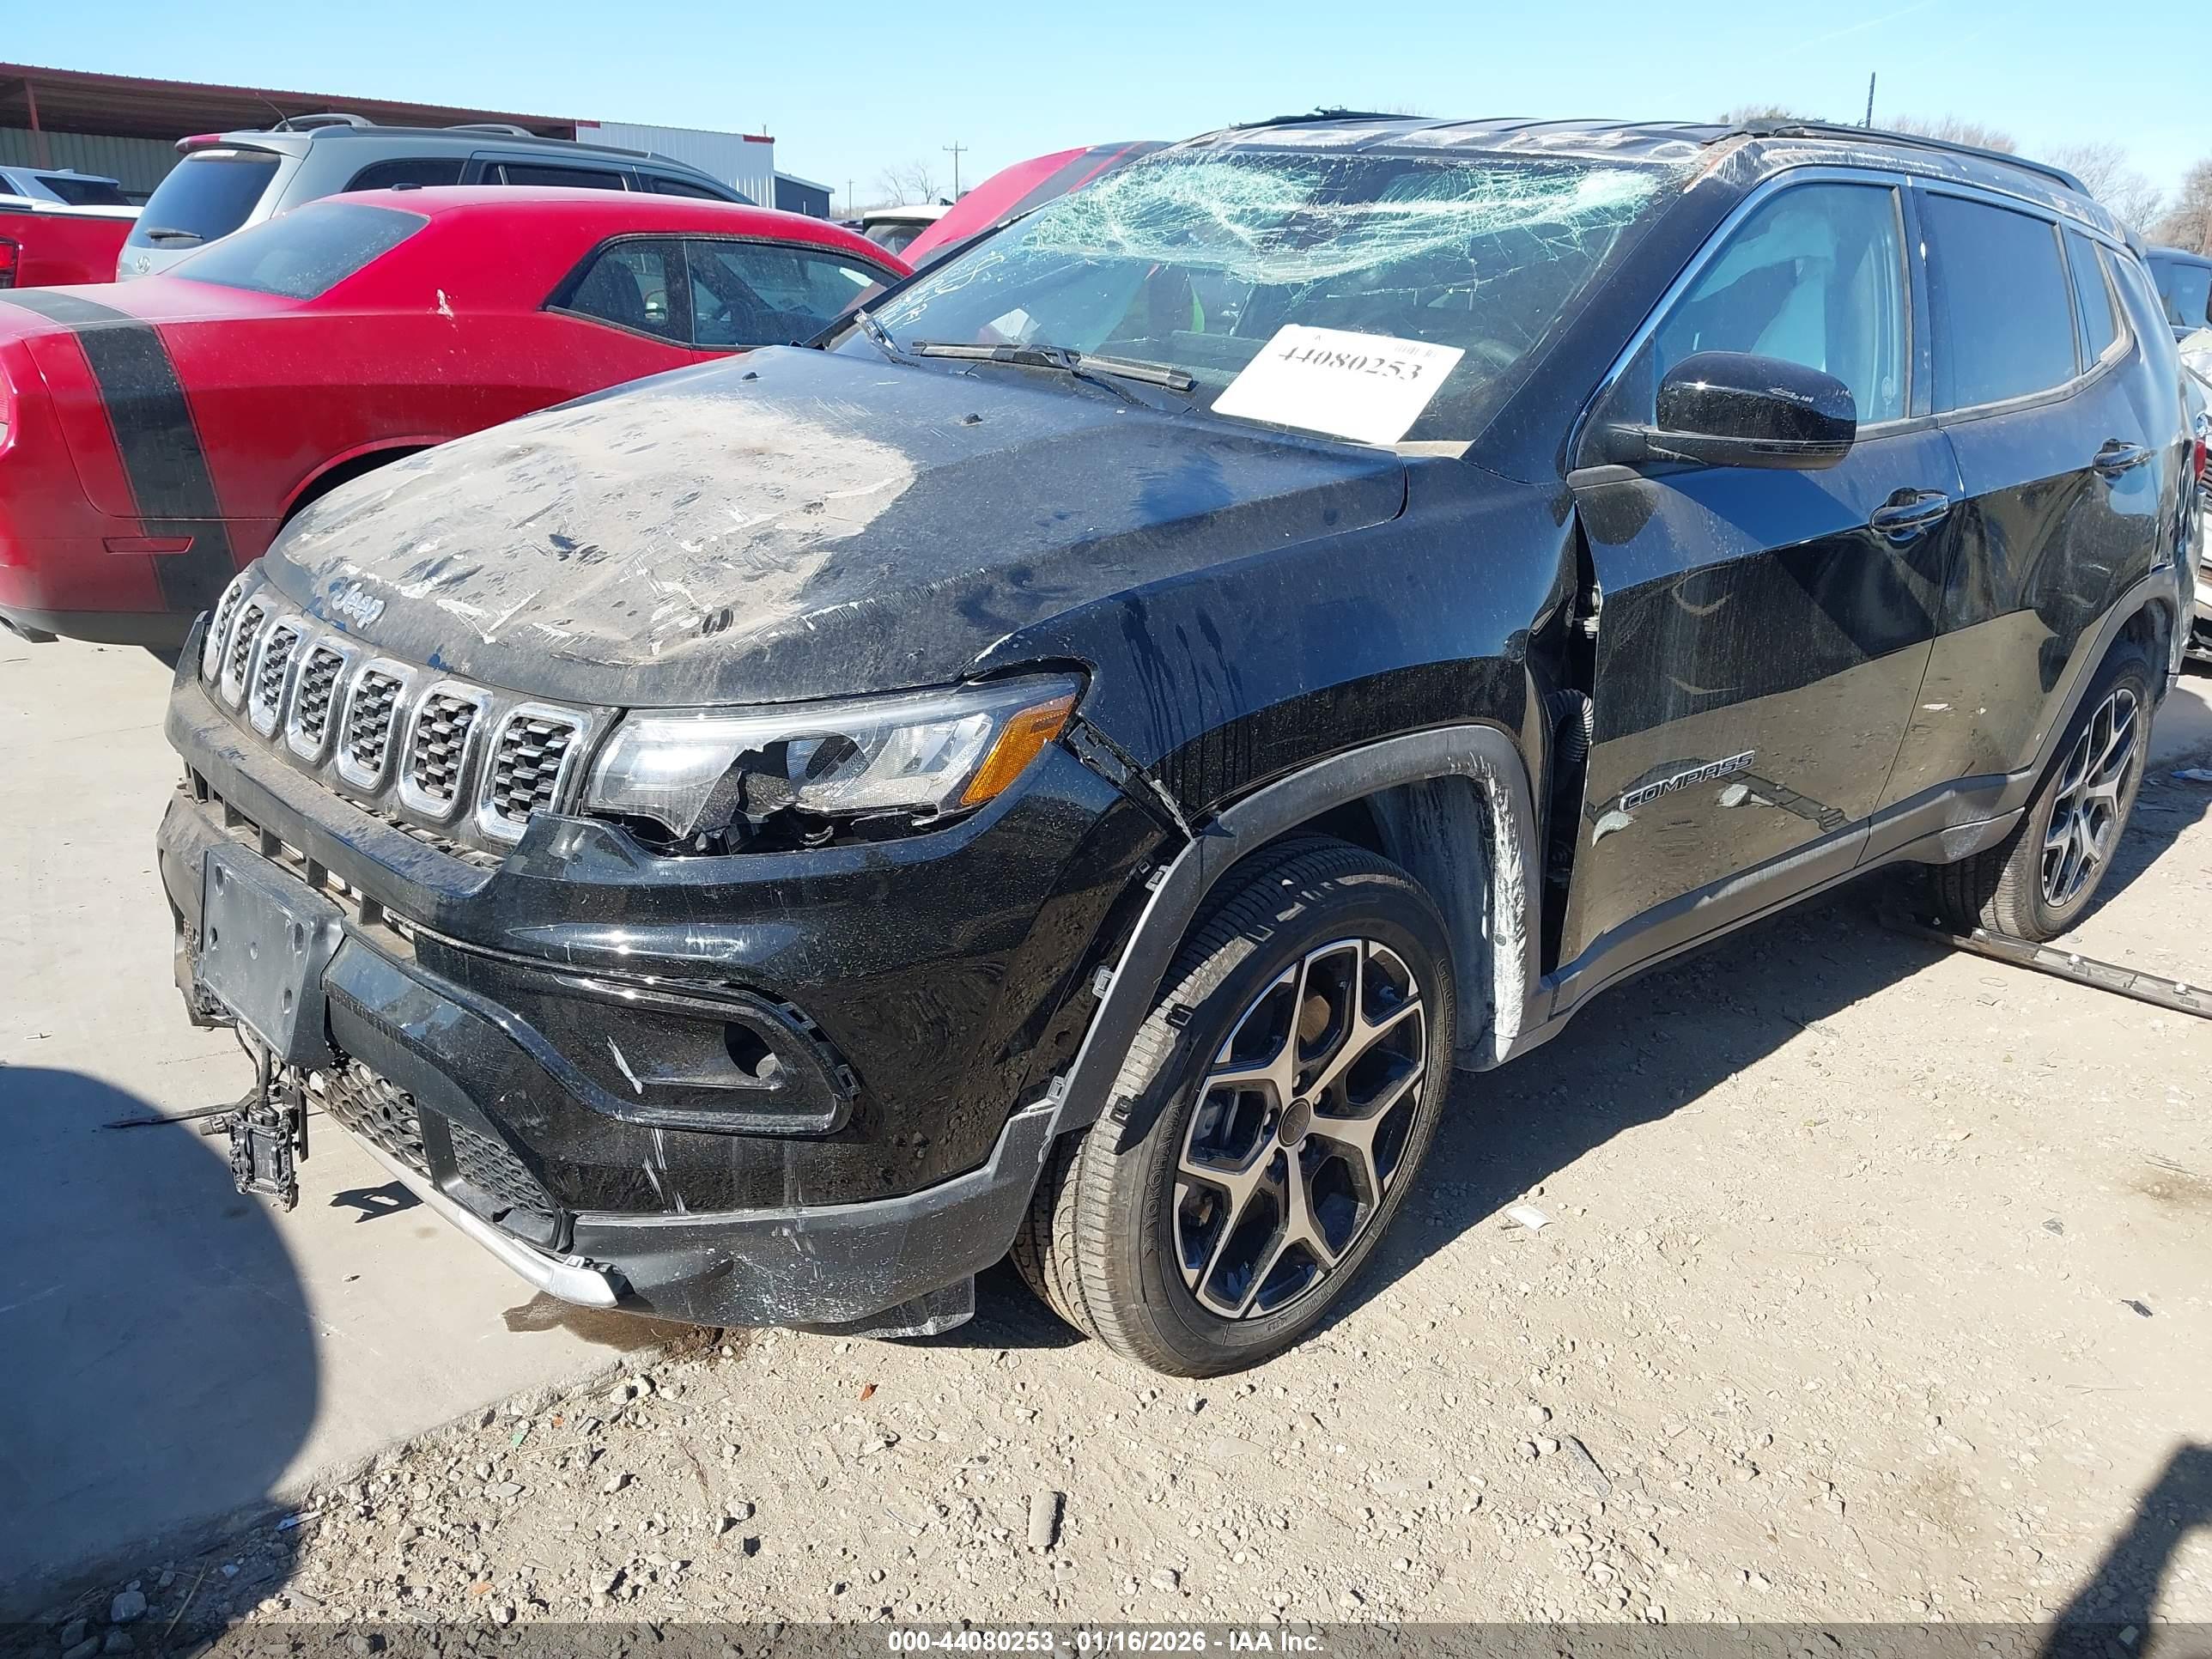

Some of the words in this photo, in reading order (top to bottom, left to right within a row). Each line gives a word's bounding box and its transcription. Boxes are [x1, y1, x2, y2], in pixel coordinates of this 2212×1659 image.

[1278, 345, 1423, 381] 44080253
[331, 581, 386, 631] Jeep
[1619, 749, 1756, 813] COMPASS
[1143, 1101, 1186, 1231] YOKOHAMA
